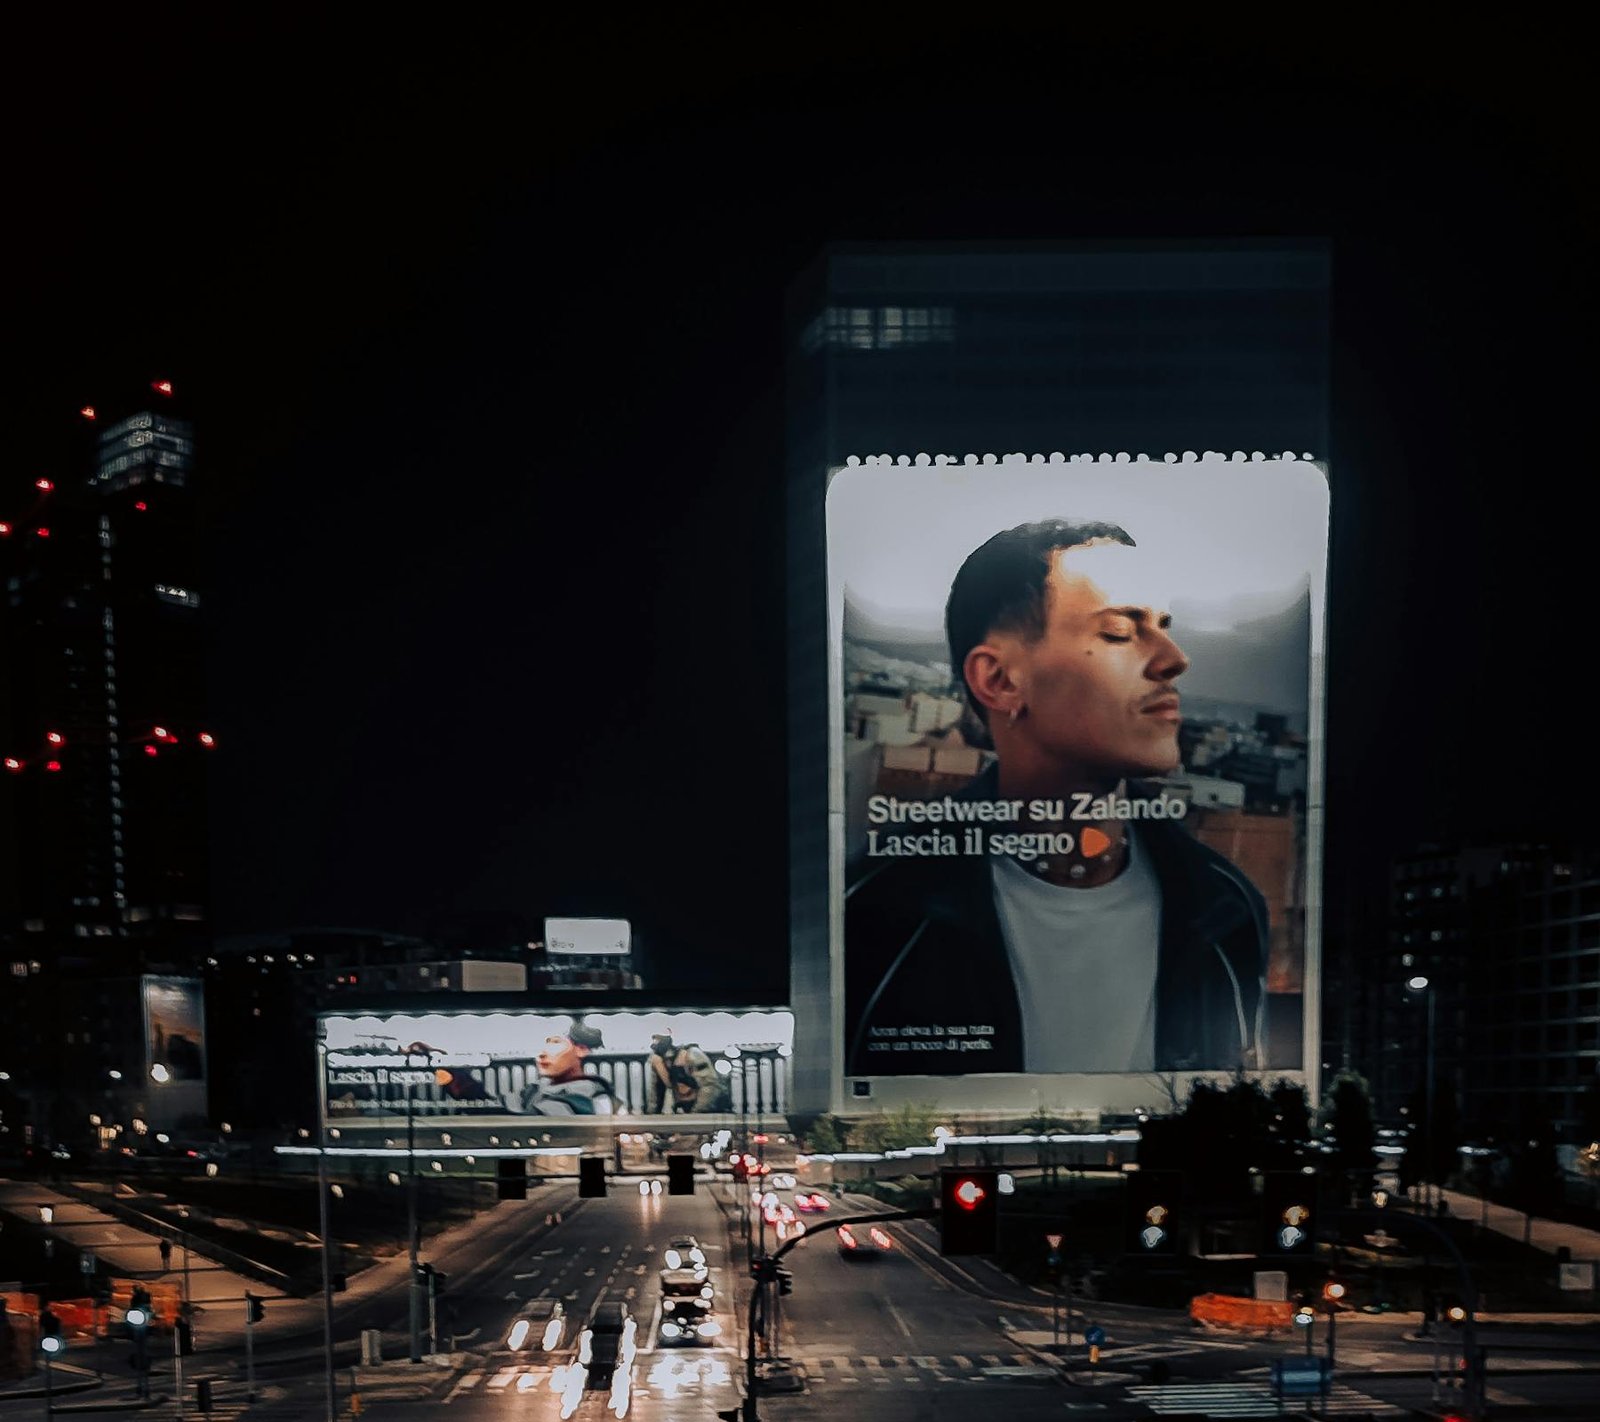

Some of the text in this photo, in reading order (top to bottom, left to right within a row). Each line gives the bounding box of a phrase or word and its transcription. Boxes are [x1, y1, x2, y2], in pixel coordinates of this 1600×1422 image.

[867, 792, 1188, 823] Streetwear su Zalando
[867, 827, 1075, 862] Lascia il segno
[328, 1069, 376, 1084] Lascia
